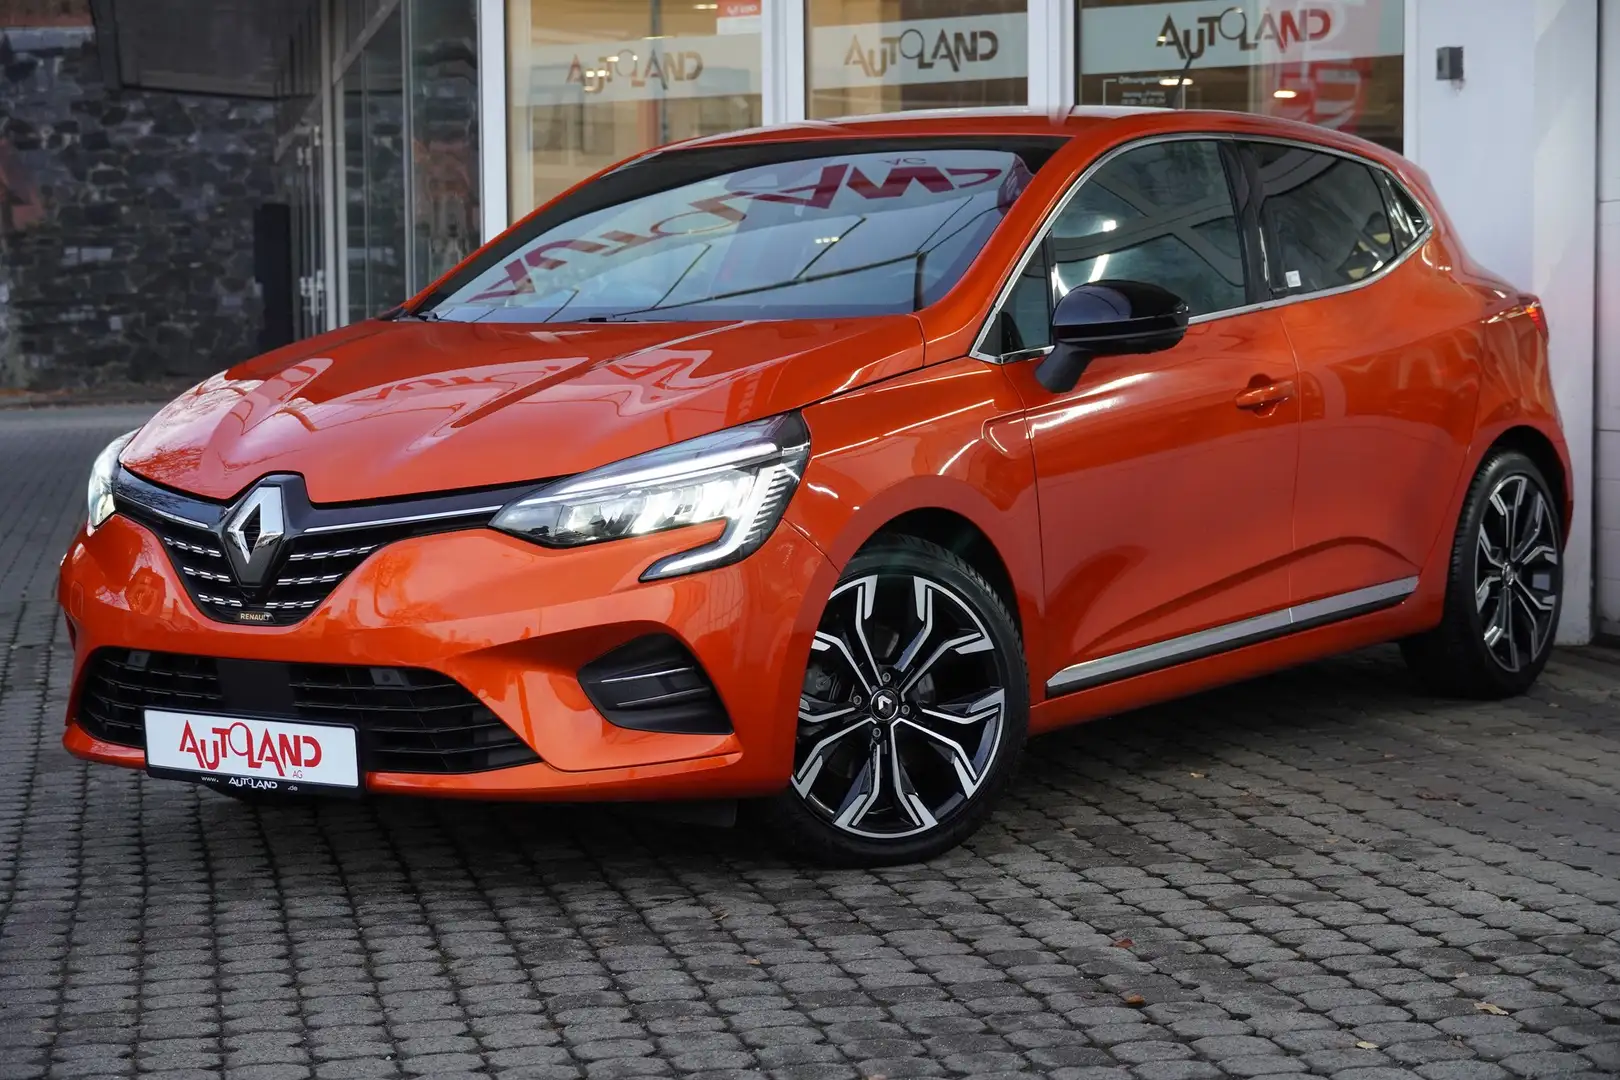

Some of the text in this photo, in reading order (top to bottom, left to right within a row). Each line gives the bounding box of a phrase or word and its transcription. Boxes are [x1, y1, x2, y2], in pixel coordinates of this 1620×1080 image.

[1156, 6, 1331, 60] AUTOLAND
[843, 28, 999, 78] AUTOLAND
[240, 613, 270, 621] RENAULT
[179, 719, 322, 777] AUTOLAND
[228, 777, 278, 790] AUTOLAND
[292, 770, 303, 780] AG
